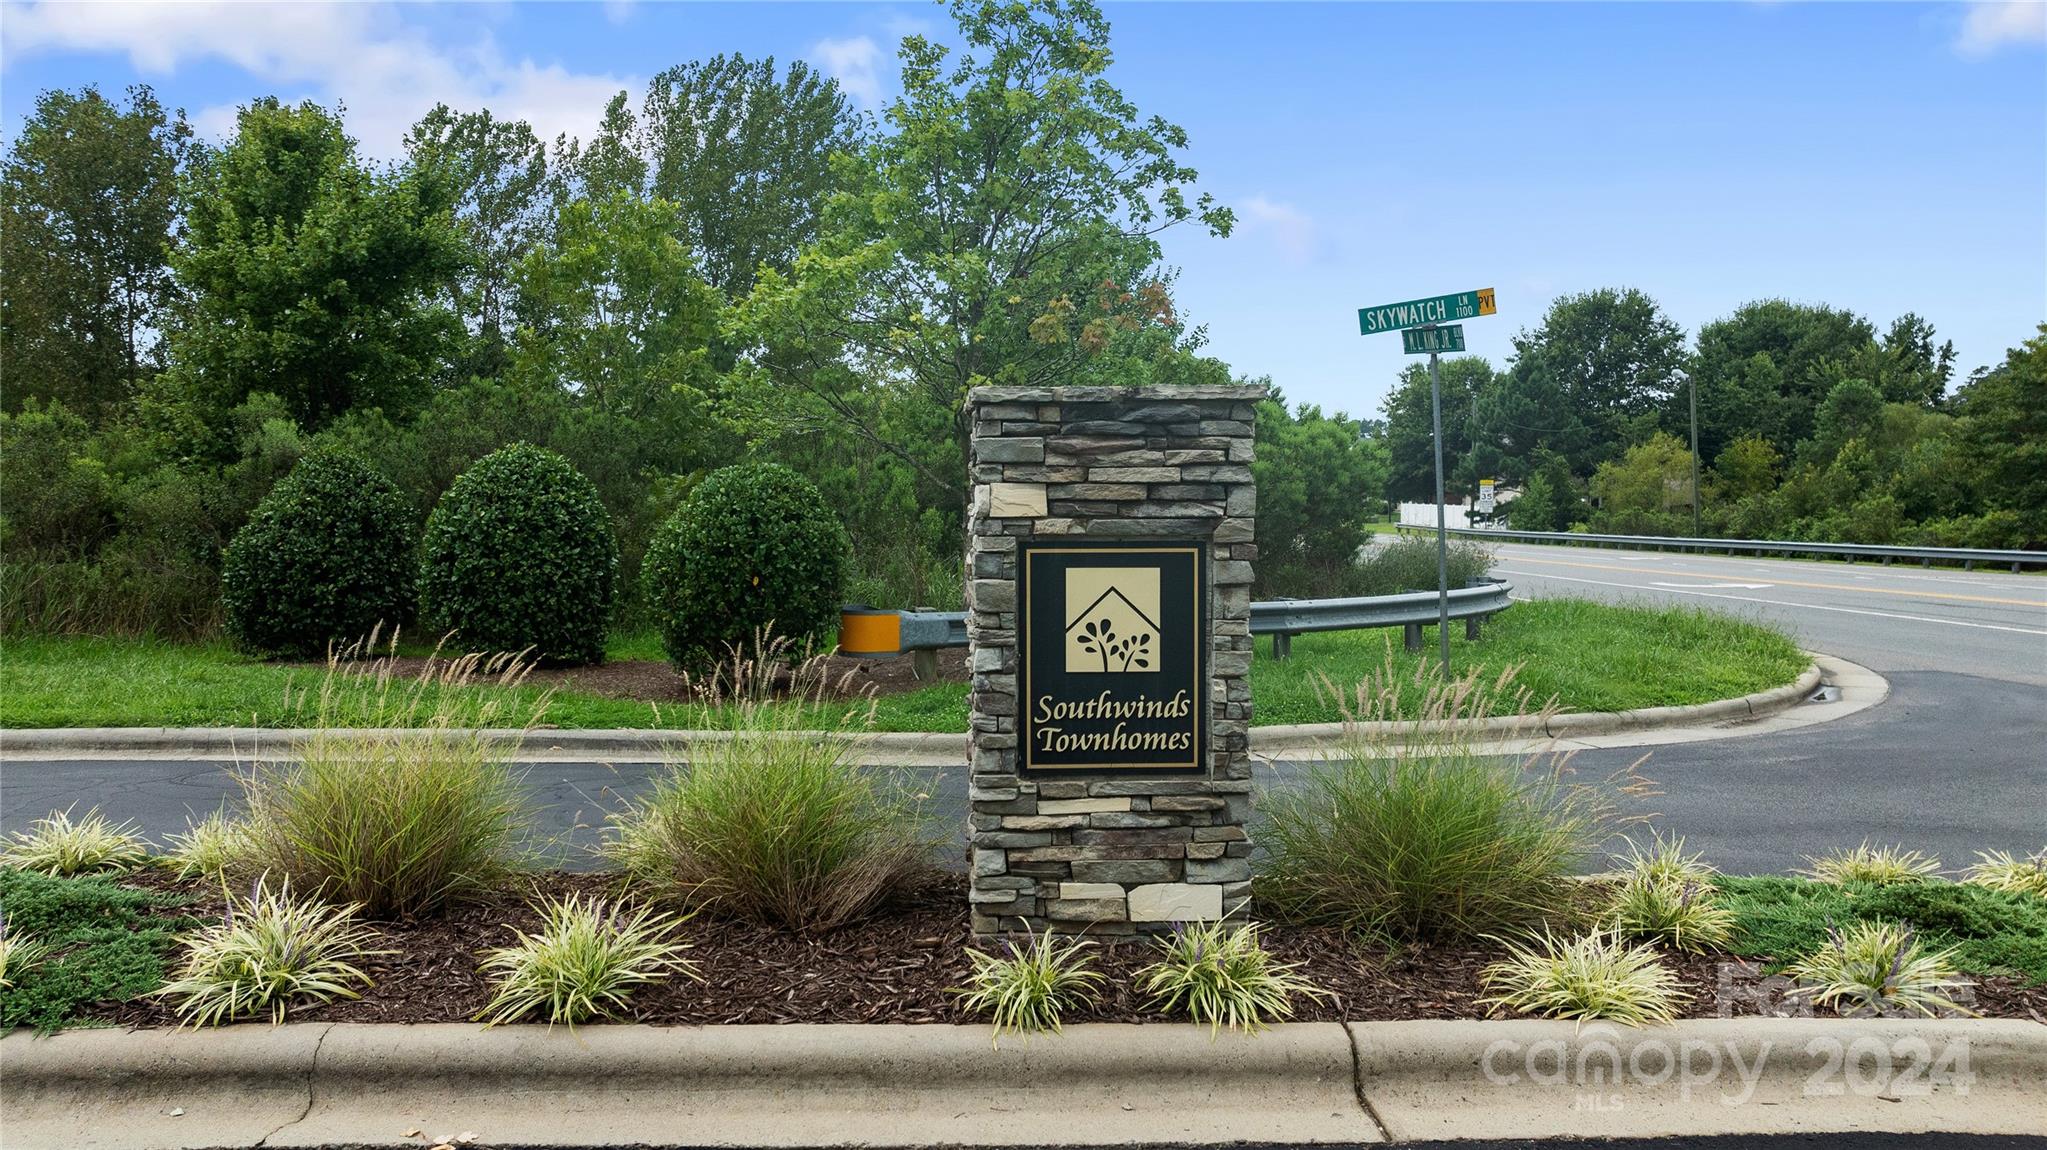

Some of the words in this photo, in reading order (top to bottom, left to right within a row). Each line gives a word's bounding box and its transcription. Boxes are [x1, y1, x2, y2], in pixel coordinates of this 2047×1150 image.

[1455, 305, 1473, 318] 1100
[1458, 294, 1469, 306] LN
[1478, 294, 1496, 310] PVT
[1367, 299, 1447, 330] SKYWATCH
[1033, 689, 1192, 724] Southwinds
[1036, 722, 1192, 752] Townhomes
